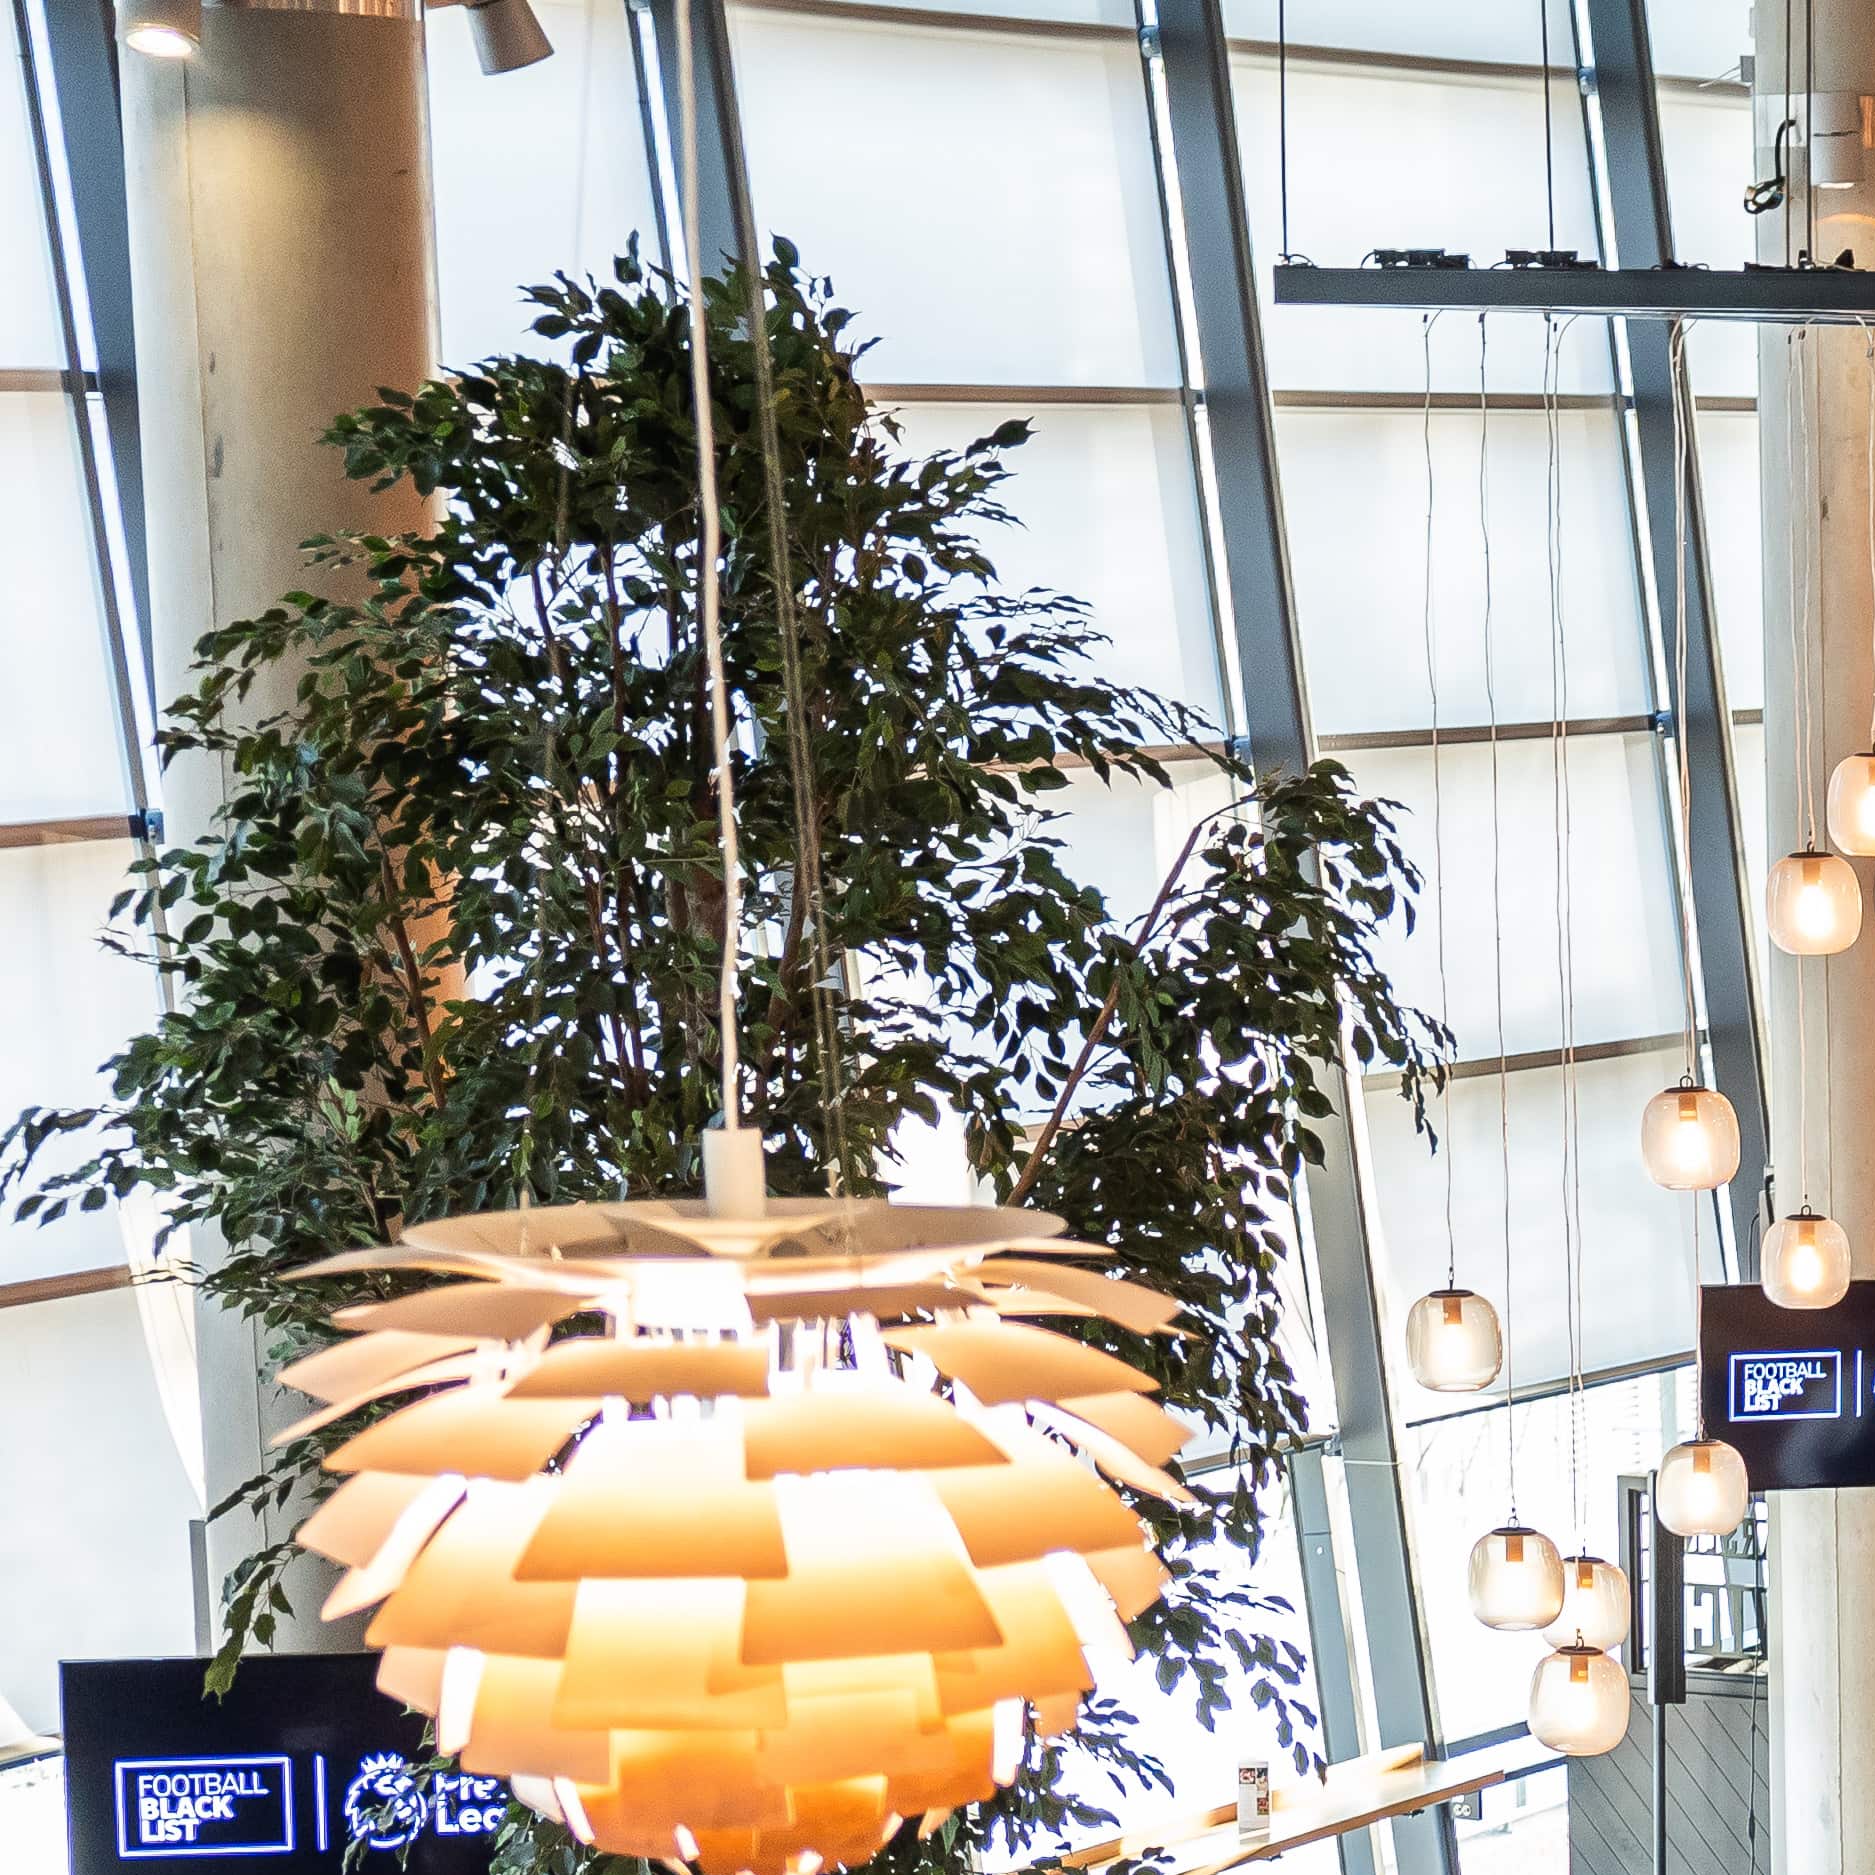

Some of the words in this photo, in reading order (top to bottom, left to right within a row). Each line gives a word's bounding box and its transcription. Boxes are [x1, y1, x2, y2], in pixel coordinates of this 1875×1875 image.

[1744, 1361, 1828, 1380] FOOTBALL
[1744, 1379, 1804, 1397] BLACK
[1744, 1394, 1783, 1412] LIST
[138, 1773, 269, 1796] FOOTBALL
[140, 1796, 235, 1820] BLACK
[140, 1817, 201, 1844] LIST
